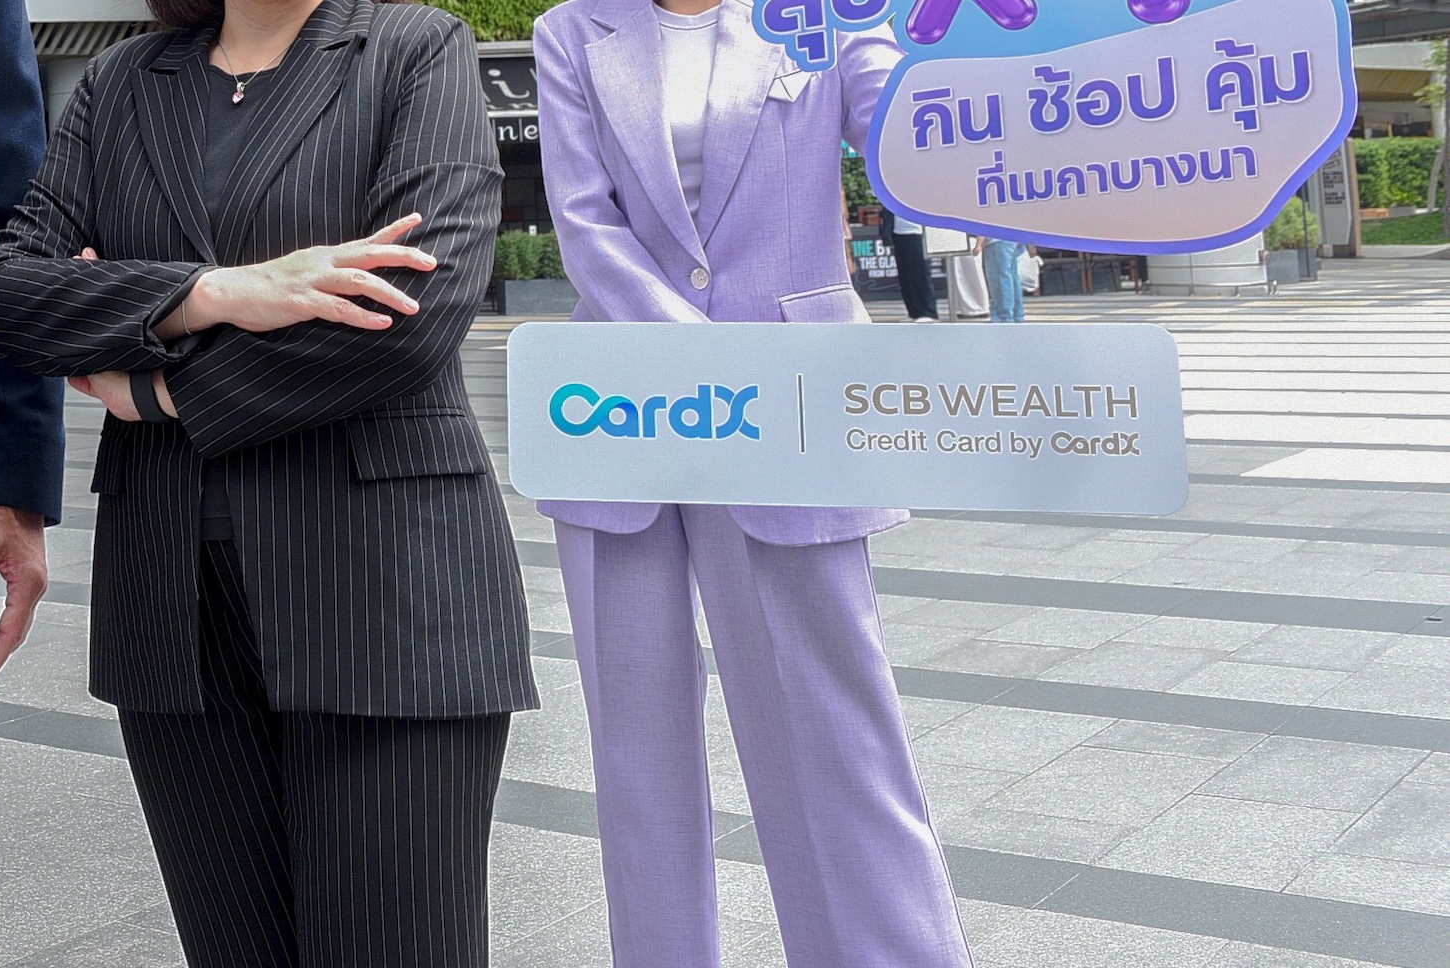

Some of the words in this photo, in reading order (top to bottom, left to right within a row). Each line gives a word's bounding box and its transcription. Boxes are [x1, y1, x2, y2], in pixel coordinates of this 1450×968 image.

[910, 85, 1005, 152] กิน
[1027, 54, 1178, 134] ช้อป
[1203, 36, 1313, 133] คุ้ม
[976, 144, 1259, 208] ที่เมกาบางนา
[548, 382, 761, 440] CardX
[844, 383, 932, 416] SCB
[938, 384, 1138, 419] WEALTH
[845, 428, 929, 452] Credit
[936, 429, 1002, 454] Card
[1010, 431, 1044, 460] by
[1050, 431, 1141, 457] CardX
